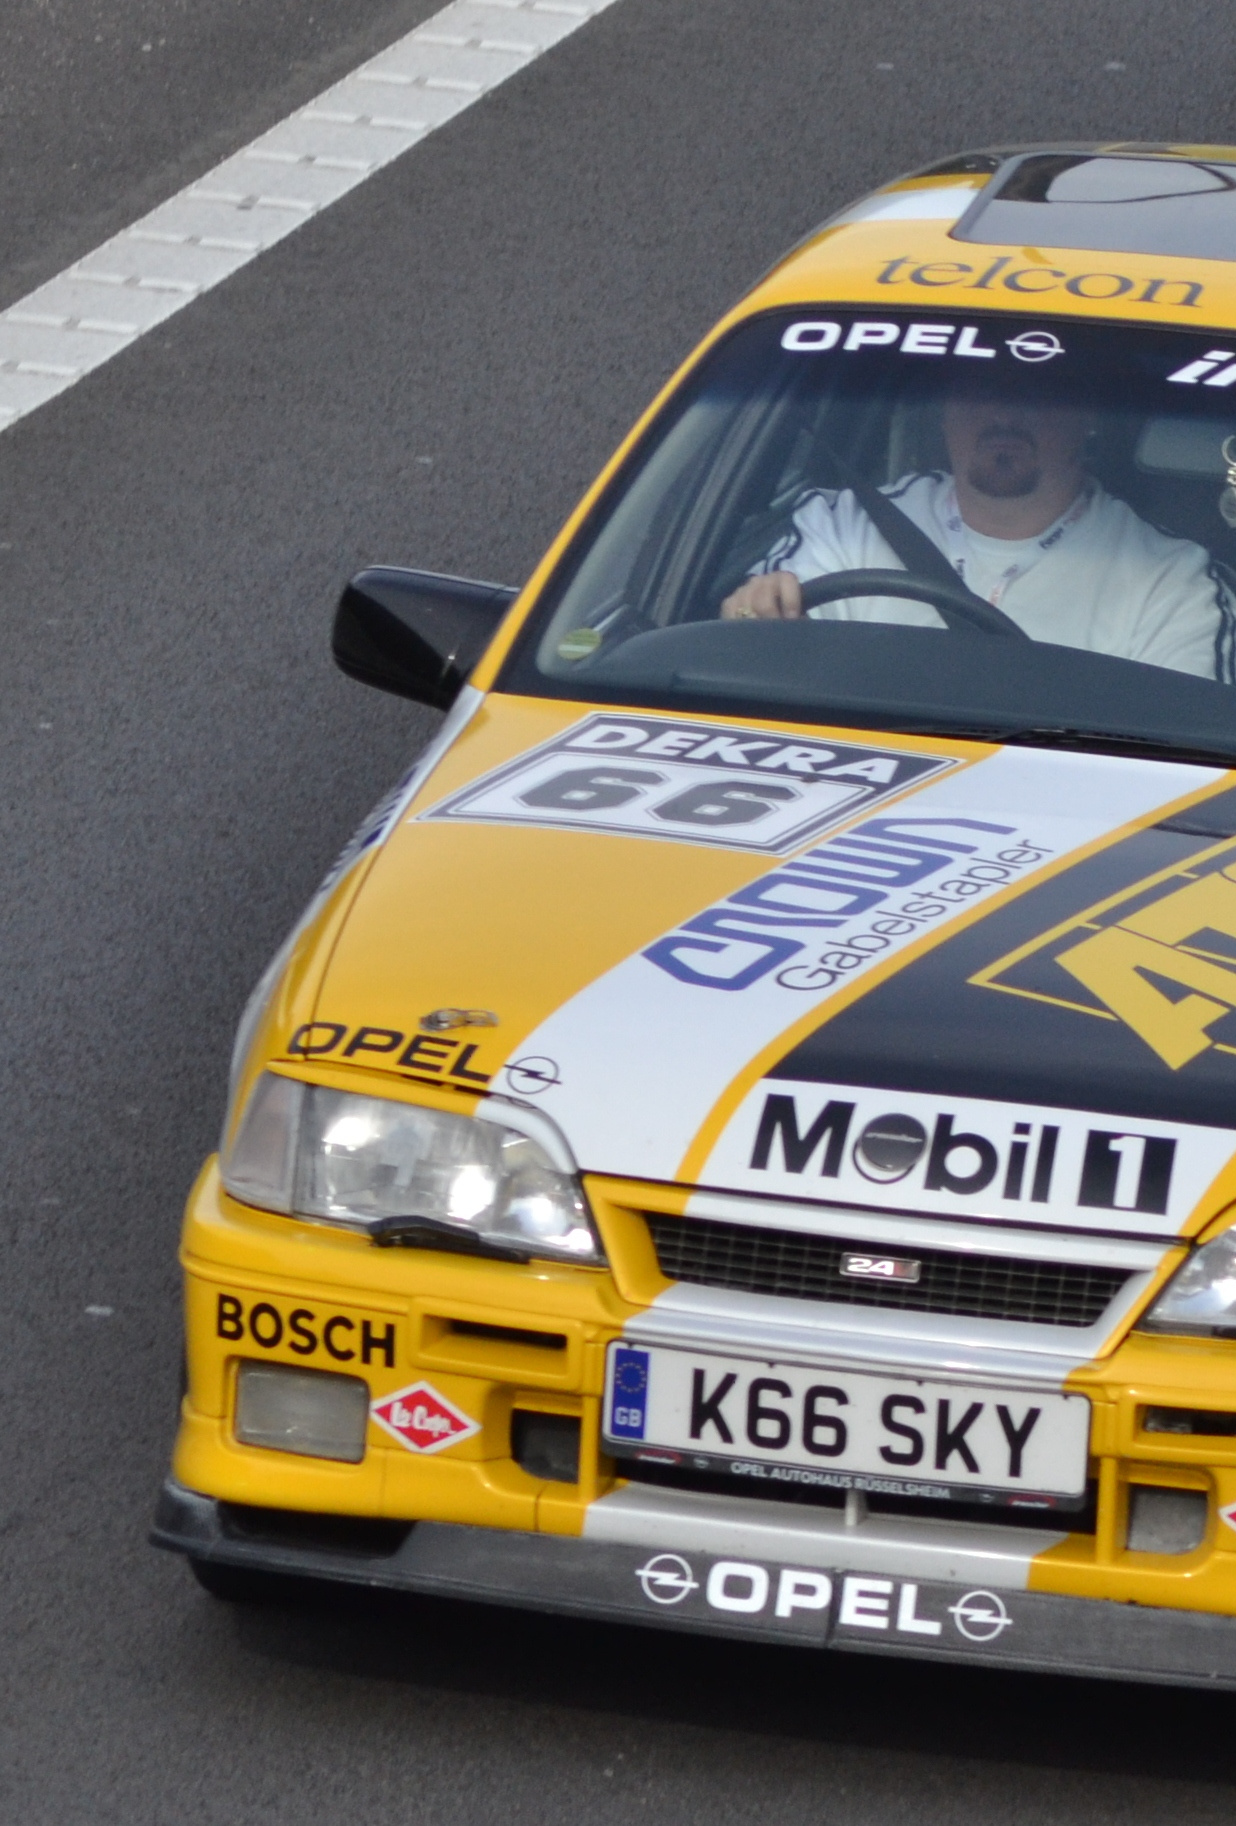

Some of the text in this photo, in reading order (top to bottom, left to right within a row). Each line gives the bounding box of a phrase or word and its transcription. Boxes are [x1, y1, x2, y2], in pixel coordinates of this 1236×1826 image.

[877, 255, 1204, 306] telcon
[780, 320, 997, 360] OPEL
[567, 724, 900, 784] DEKRA
[514, 766, 805, 827] 66
[775, 838, 1054, 992] Gabelstapler
[287, 1022, 493, 1083] OPEL
[749, 1093, 1147, 1209] Mobil 1
[217, 1293, 396, 1369] BOSCH
[614, 1406, 642, 1428] GB
[689, 1367, 1042, 1479] K66 SKY
[730, 1461, 768, 1479] OPEL
[770, 1466, 852, 1490] AUTOHAUS
[706, 1561, 943, 1636] OPEL
